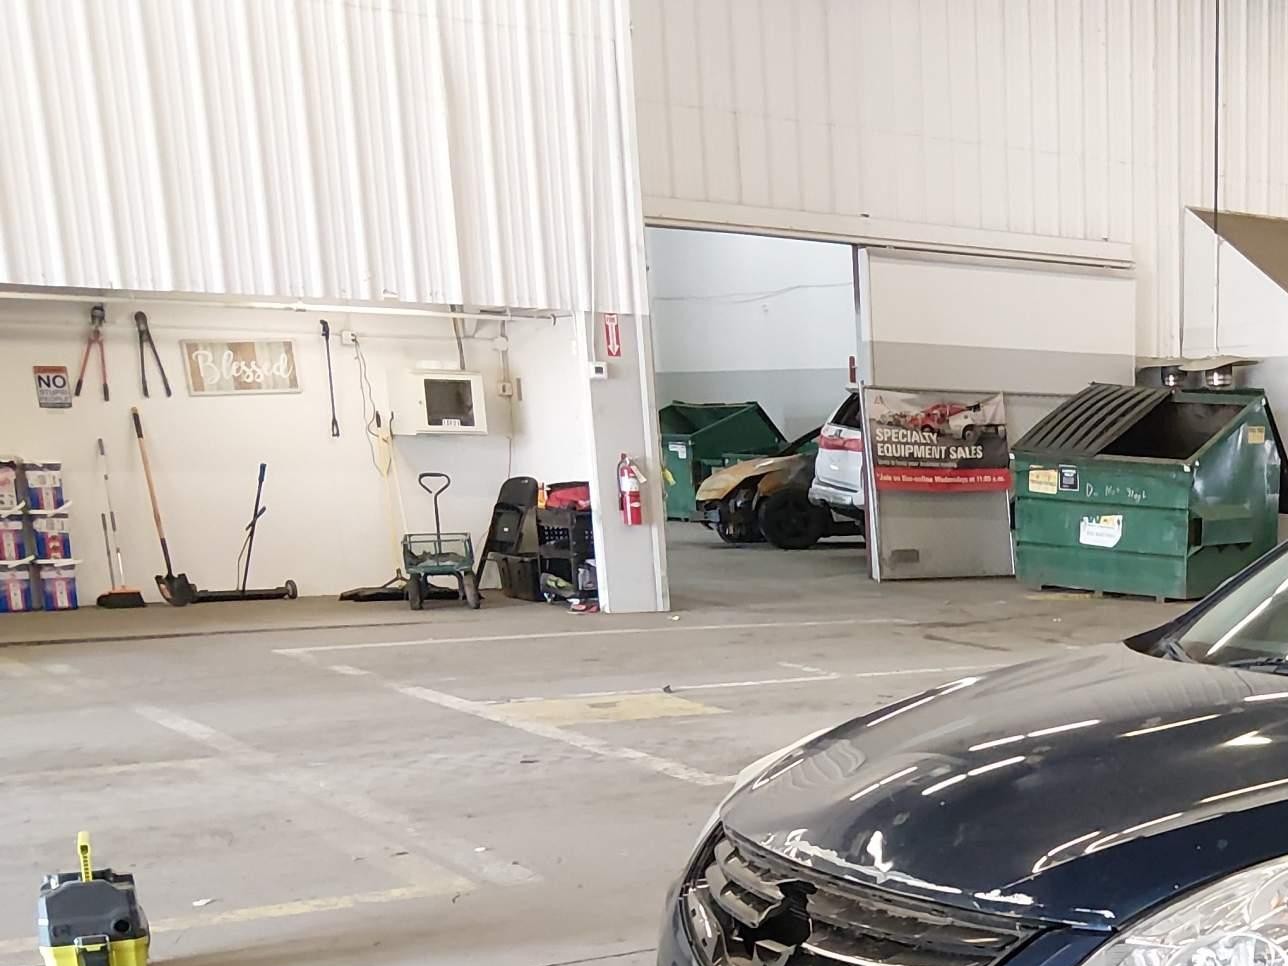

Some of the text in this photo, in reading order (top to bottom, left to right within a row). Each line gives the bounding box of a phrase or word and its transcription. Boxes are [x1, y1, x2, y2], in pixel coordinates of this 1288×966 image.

[192, 350, 294, 385] Blessed
[38, 375, 67, 388] NO
[876, 428, 938, 444] SPECIALTY
[877, 443, 983, 459] EQUIPMENT SALES
